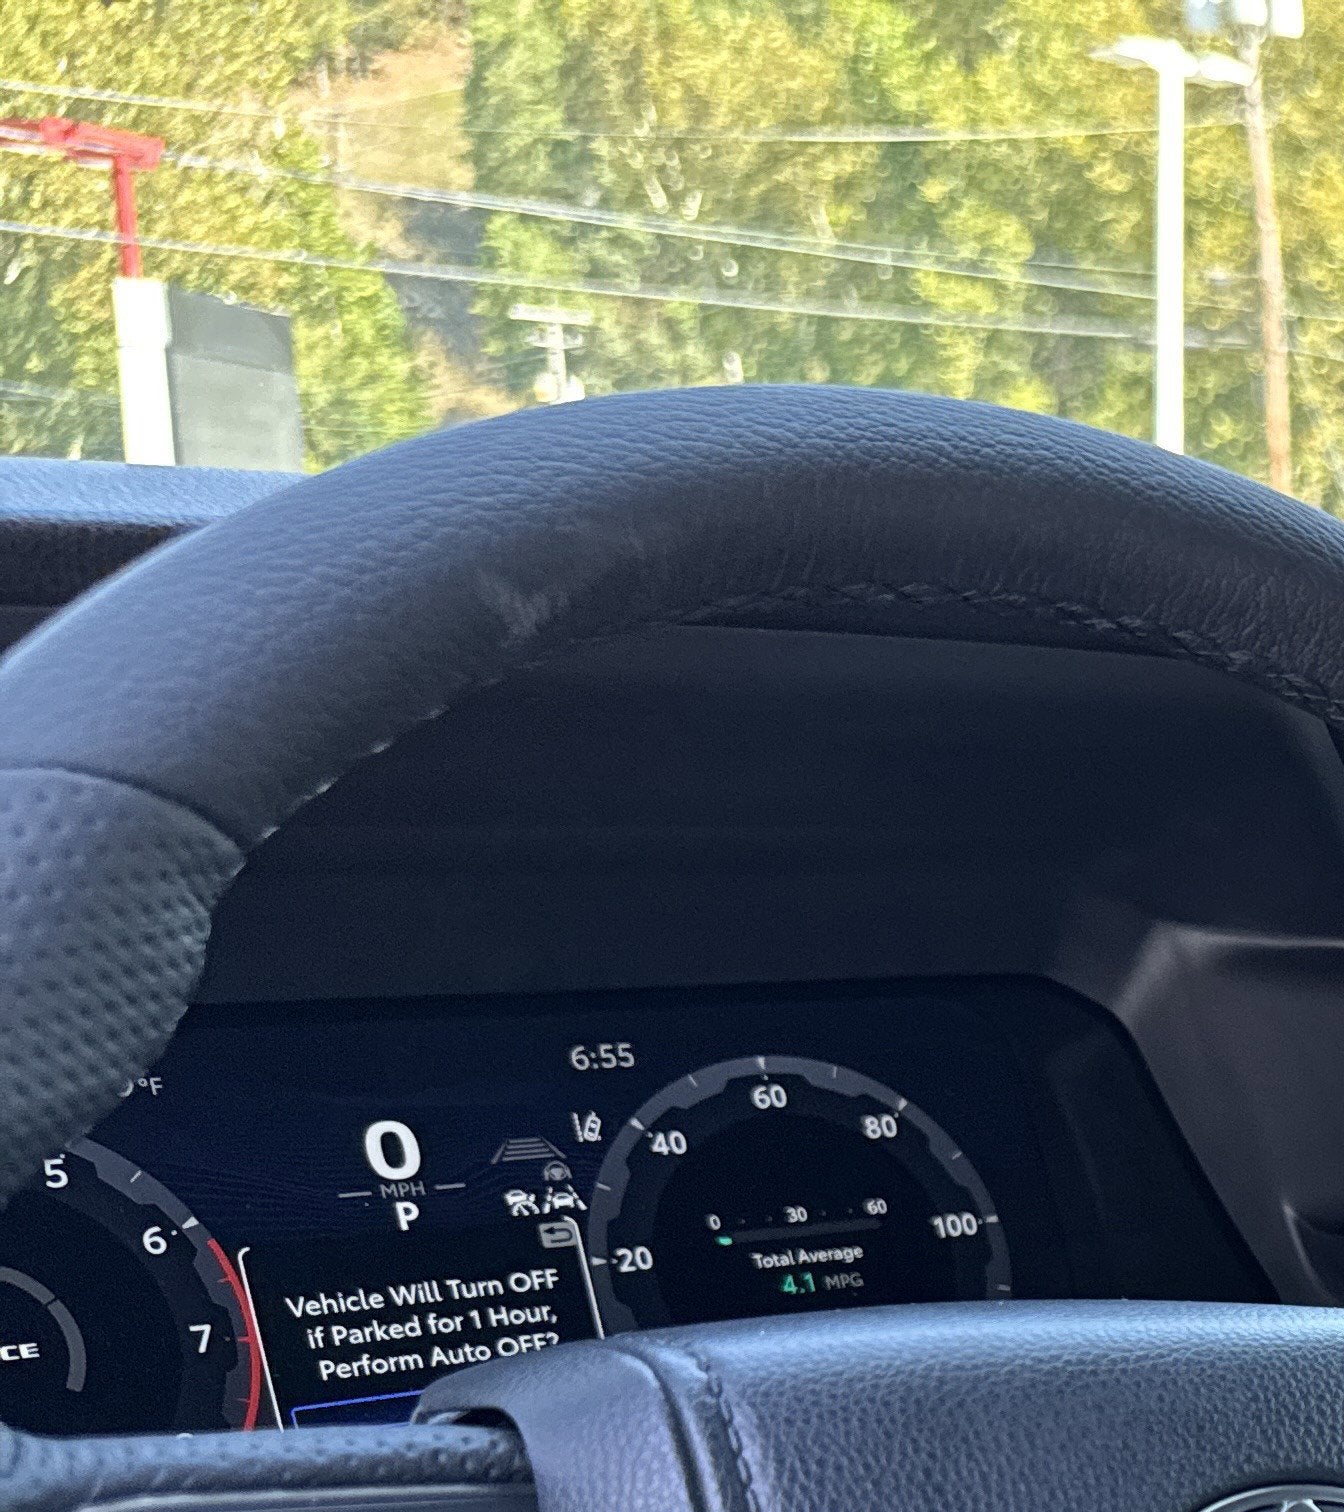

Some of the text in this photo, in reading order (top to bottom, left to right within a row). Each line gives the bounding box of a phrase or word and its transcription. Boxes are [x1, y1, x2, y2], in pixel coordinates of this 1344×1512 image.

[570, 1042, 635, 1071] 6:55
[750, 1083, 788, 1109] 60
[861, 1114, 898, 1139] 80
[363, 1119, 422, 1181] 0
[650, 1129, 688, 1156] 40
[43, 1157, 70, 1189] 5
[379, 1181, 427, 1198] MPH
[395, 1201, 420, 1231] P
[784, 1205, 808, 1224] 30
[863, 1198, 888, 1216] 60
[705, 1213, 721, 1231] 0
[932, 1213, 979, 1239] 100
[142, 1226, 168, 1255] 6
[615, 1246, 654, 1272] 20
[751, 1245, 864, 1269] Total Average
[285, 1267, 560, 1318] Vehicle Will Turn OFF
[780, 1270, 865, 1294] 4.1 MPG
[189, 1322, 213, 1353] 7
[306, 1304, 559, 1349] if Parked for 1 Hour,
[318, 1331, 560, 1381] Perform Auto OFF?
